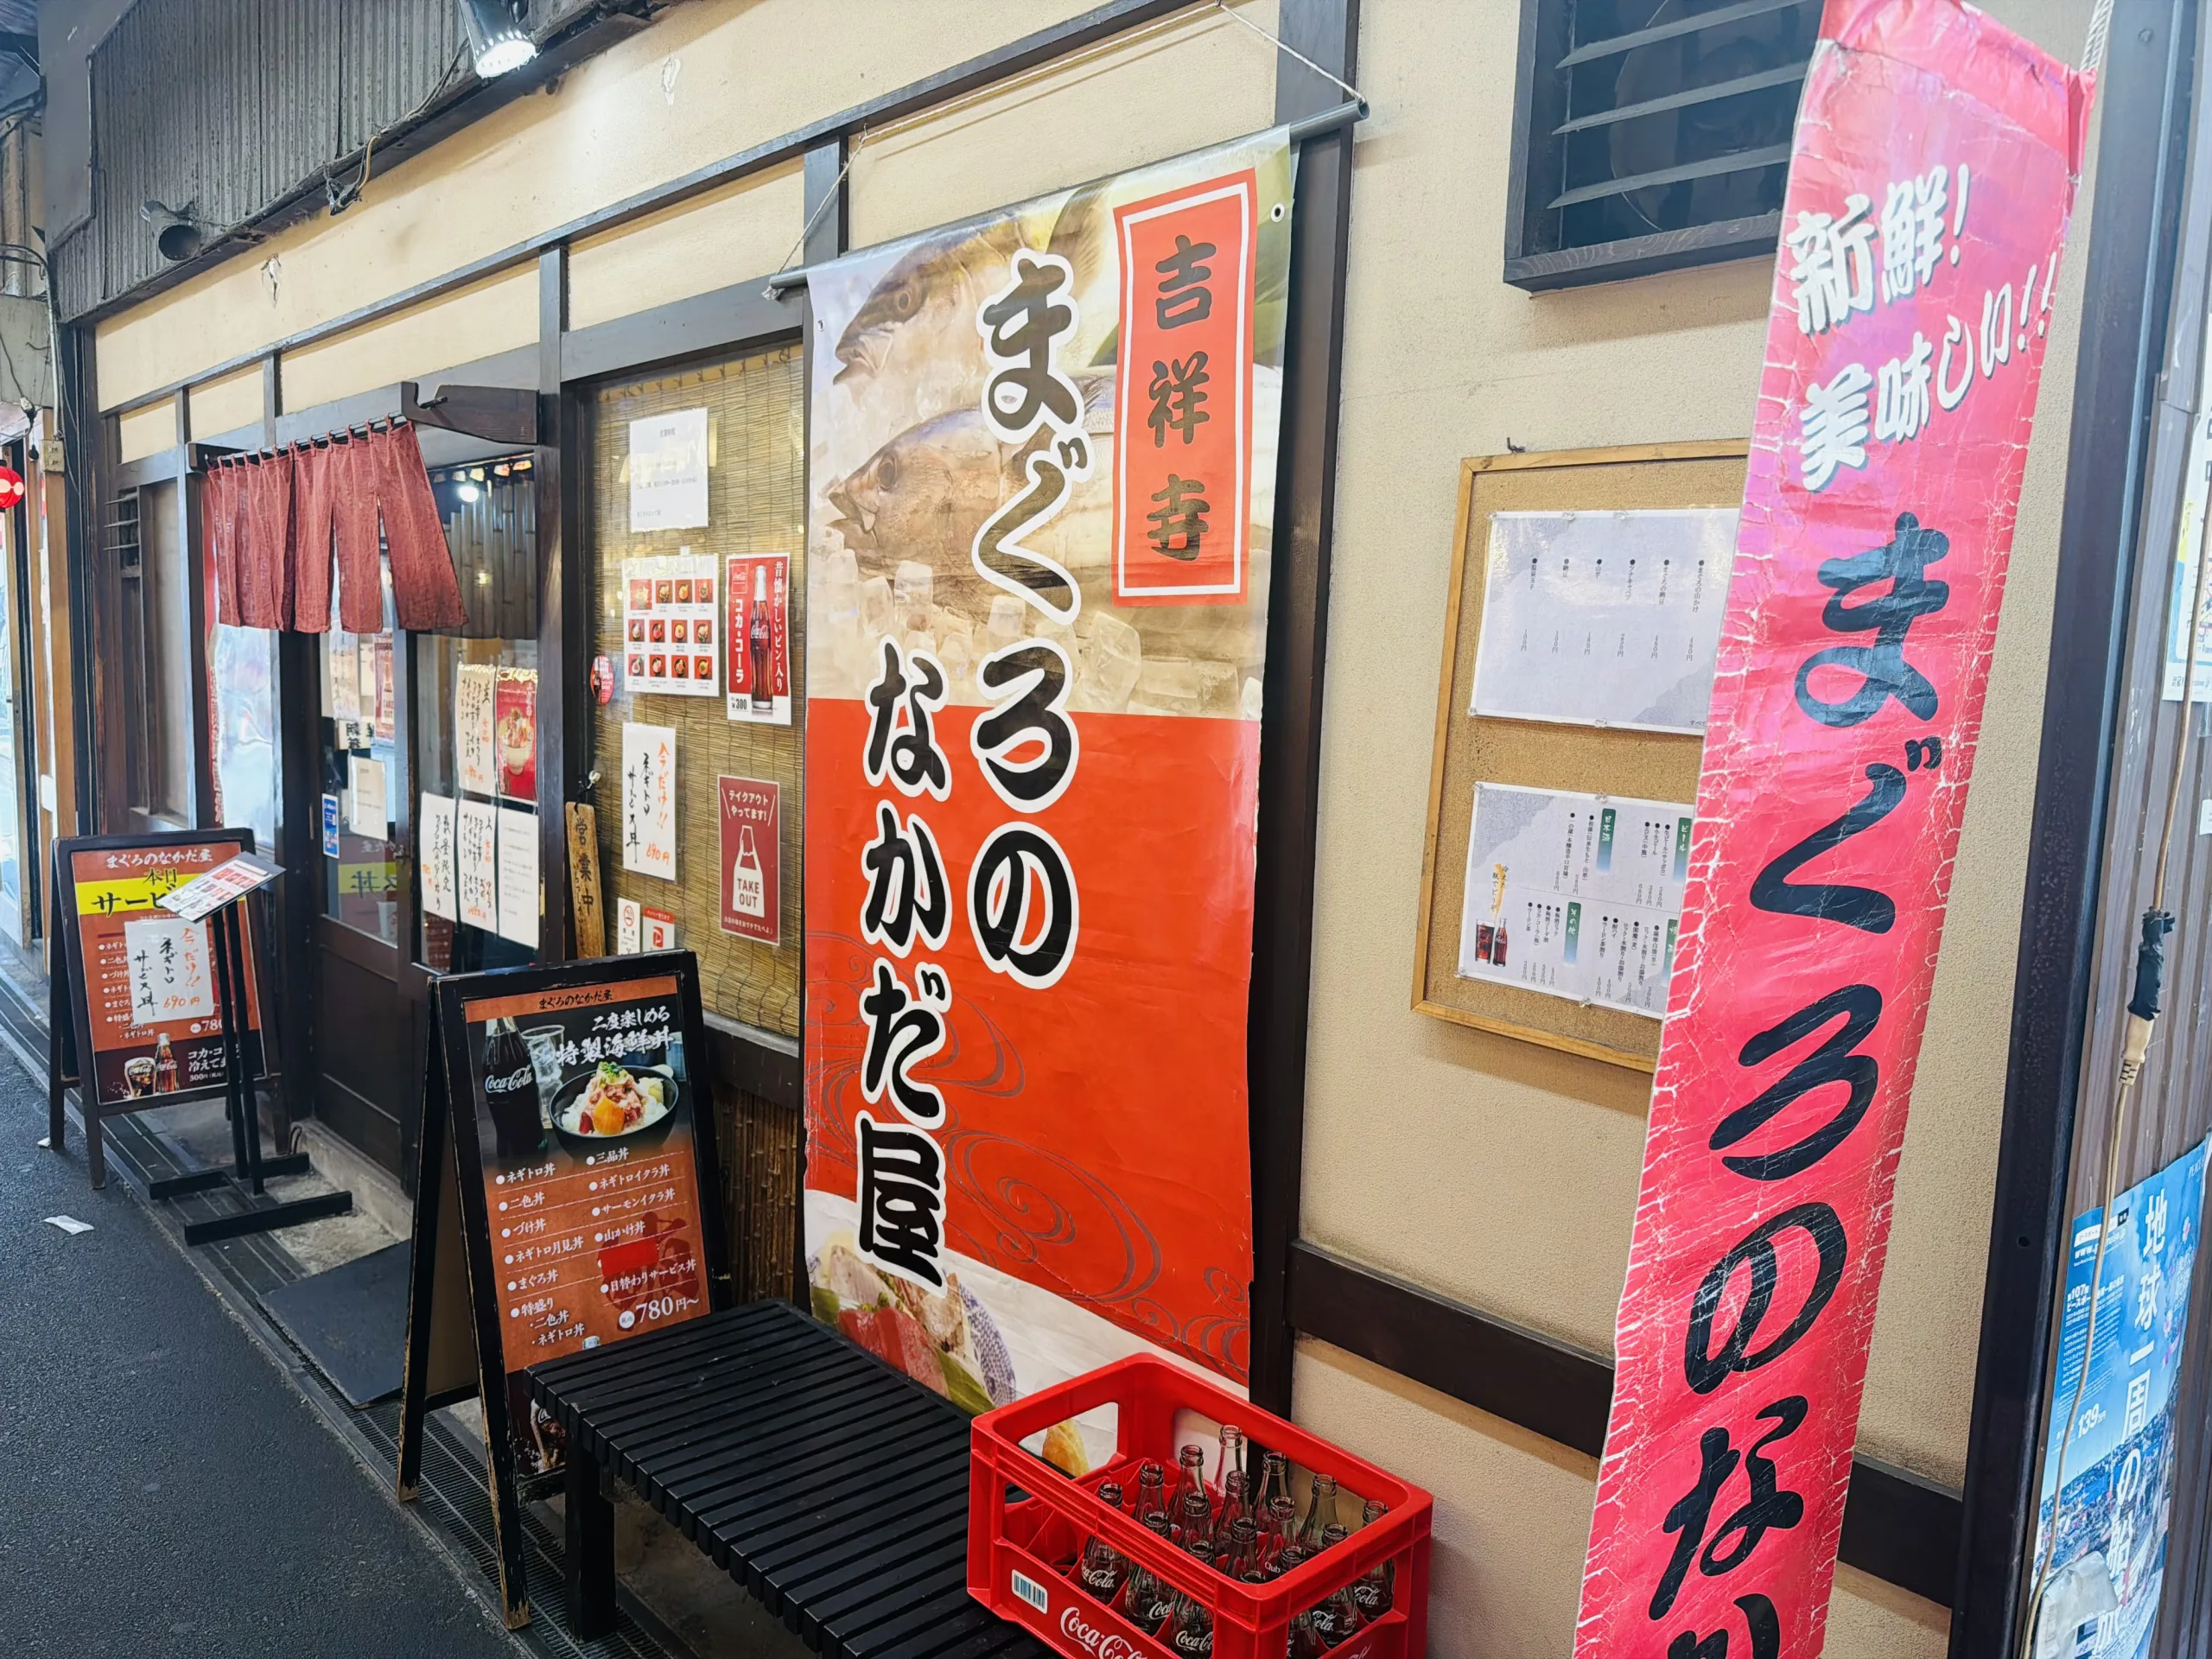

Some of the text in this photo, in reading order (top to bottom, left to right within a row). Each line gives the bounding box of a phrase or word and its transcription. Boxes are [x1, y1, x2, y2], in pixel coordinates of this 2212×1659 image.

[1787, 162, 1971, 335] 新鮮!
[1145, 233, 1217, 562] 吉祥寺
[969, 249, 1094, 990] まぐろの
[734, 598, 744, 683] コカ・コーラ
[728, 790, 768, 807] テイクアウト
[731, 804, 767, 822] やってます!
[1679, 824, 1690, 852] ビール
[105, 849, 213, 869] まぐろのなかだ屋
[575, 817, 594, 916] 営業中
[143, 868, 178, 887] 本日
[737, 878, 760, 894] TAKE
[739, 893, 758, 909] OUT
[1567, 908, 1577, 936] その他
[105, 941, 127, 950] ネギト
[855, 639, 952, 1298] なかだ屋
[111, 984, 131, 993] ネギト
[538, 989, 613, 1010] まぐろのなかだ屋
[163, 995, 200, 1010] 690円
[592, 1006, 671, 1032] 二度楽しめる
[555, 1026, 674, 1067] 特製海鮮丼
[485, 1065, 533, 1094] Coca-Cola
[595, 1147, 629, 1165] 三品丼
[506, 1162, 556, 1184] ネギトロ丼
[599, 1164, 671, 1190] ネギトロイクラ丼
[509, 1192, 545, 1210] 二色丼
[601, 1187, 676, 1215] サーモンイクラ丼
[512, 1218, 547, 1236] づけ丼
[604, 1221, 646, 1242] 山かけ丼
[516, 1236, 584, 1263] ネギトロ月見丼
[518, 1268, 559, 1290] まぐろ丼
[609, 1258, 697, 1293] 日替わりサービス丼
[520, 1297, 554, 1317] 特盛り
[534, 1310, 569, 1329] 二色丼
[537, 1323, 585, 1345] ネギトロ丼
[1264, 1561, 1281, 1573] Club
